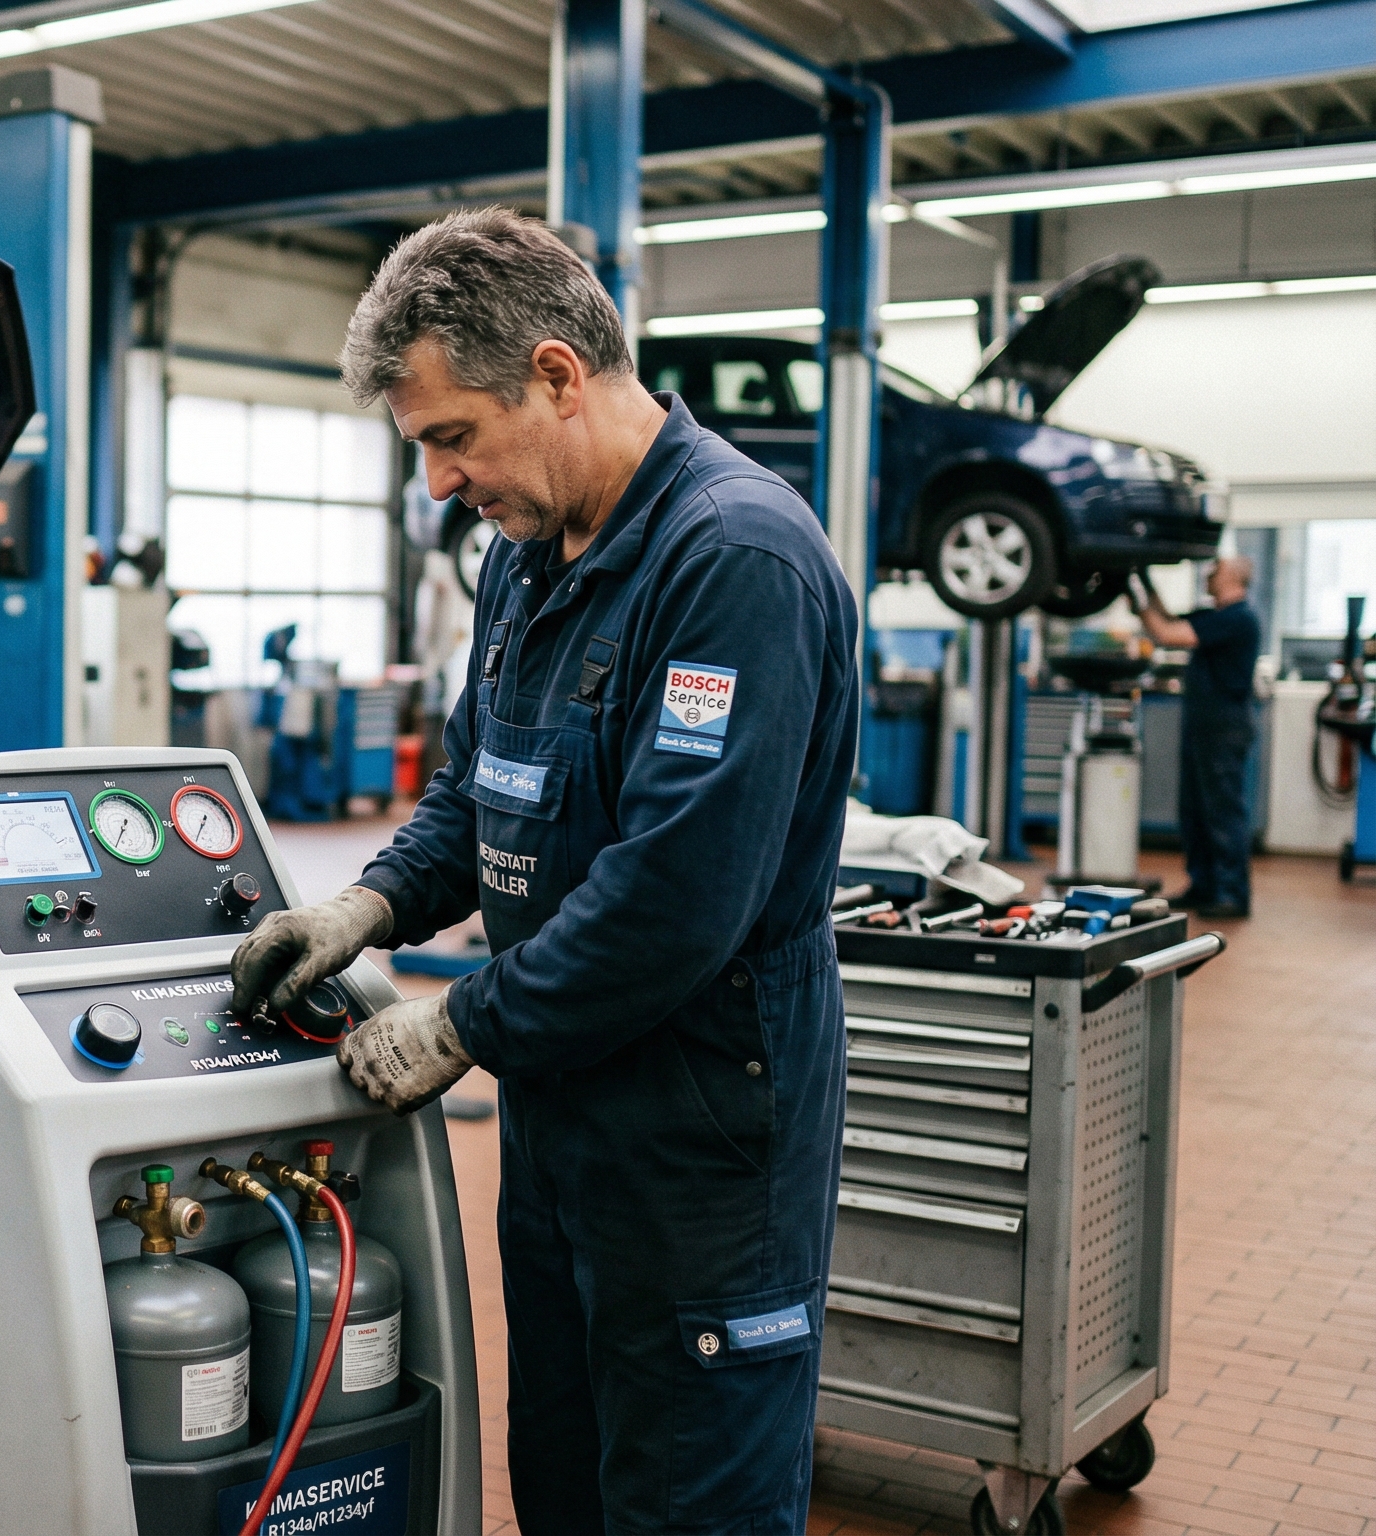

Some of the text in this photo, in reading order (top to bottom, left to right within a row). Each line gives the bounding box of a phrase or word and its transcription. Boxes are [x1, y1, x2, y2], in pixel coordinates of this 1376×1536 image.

[671, 673, 730, 694] BOSCH
[668, 690, 727, 710] Service
[246, 1466, 385, 1521] KIMASERVICE
[268, 1496, 375, 1536] R134a/R1234yf
